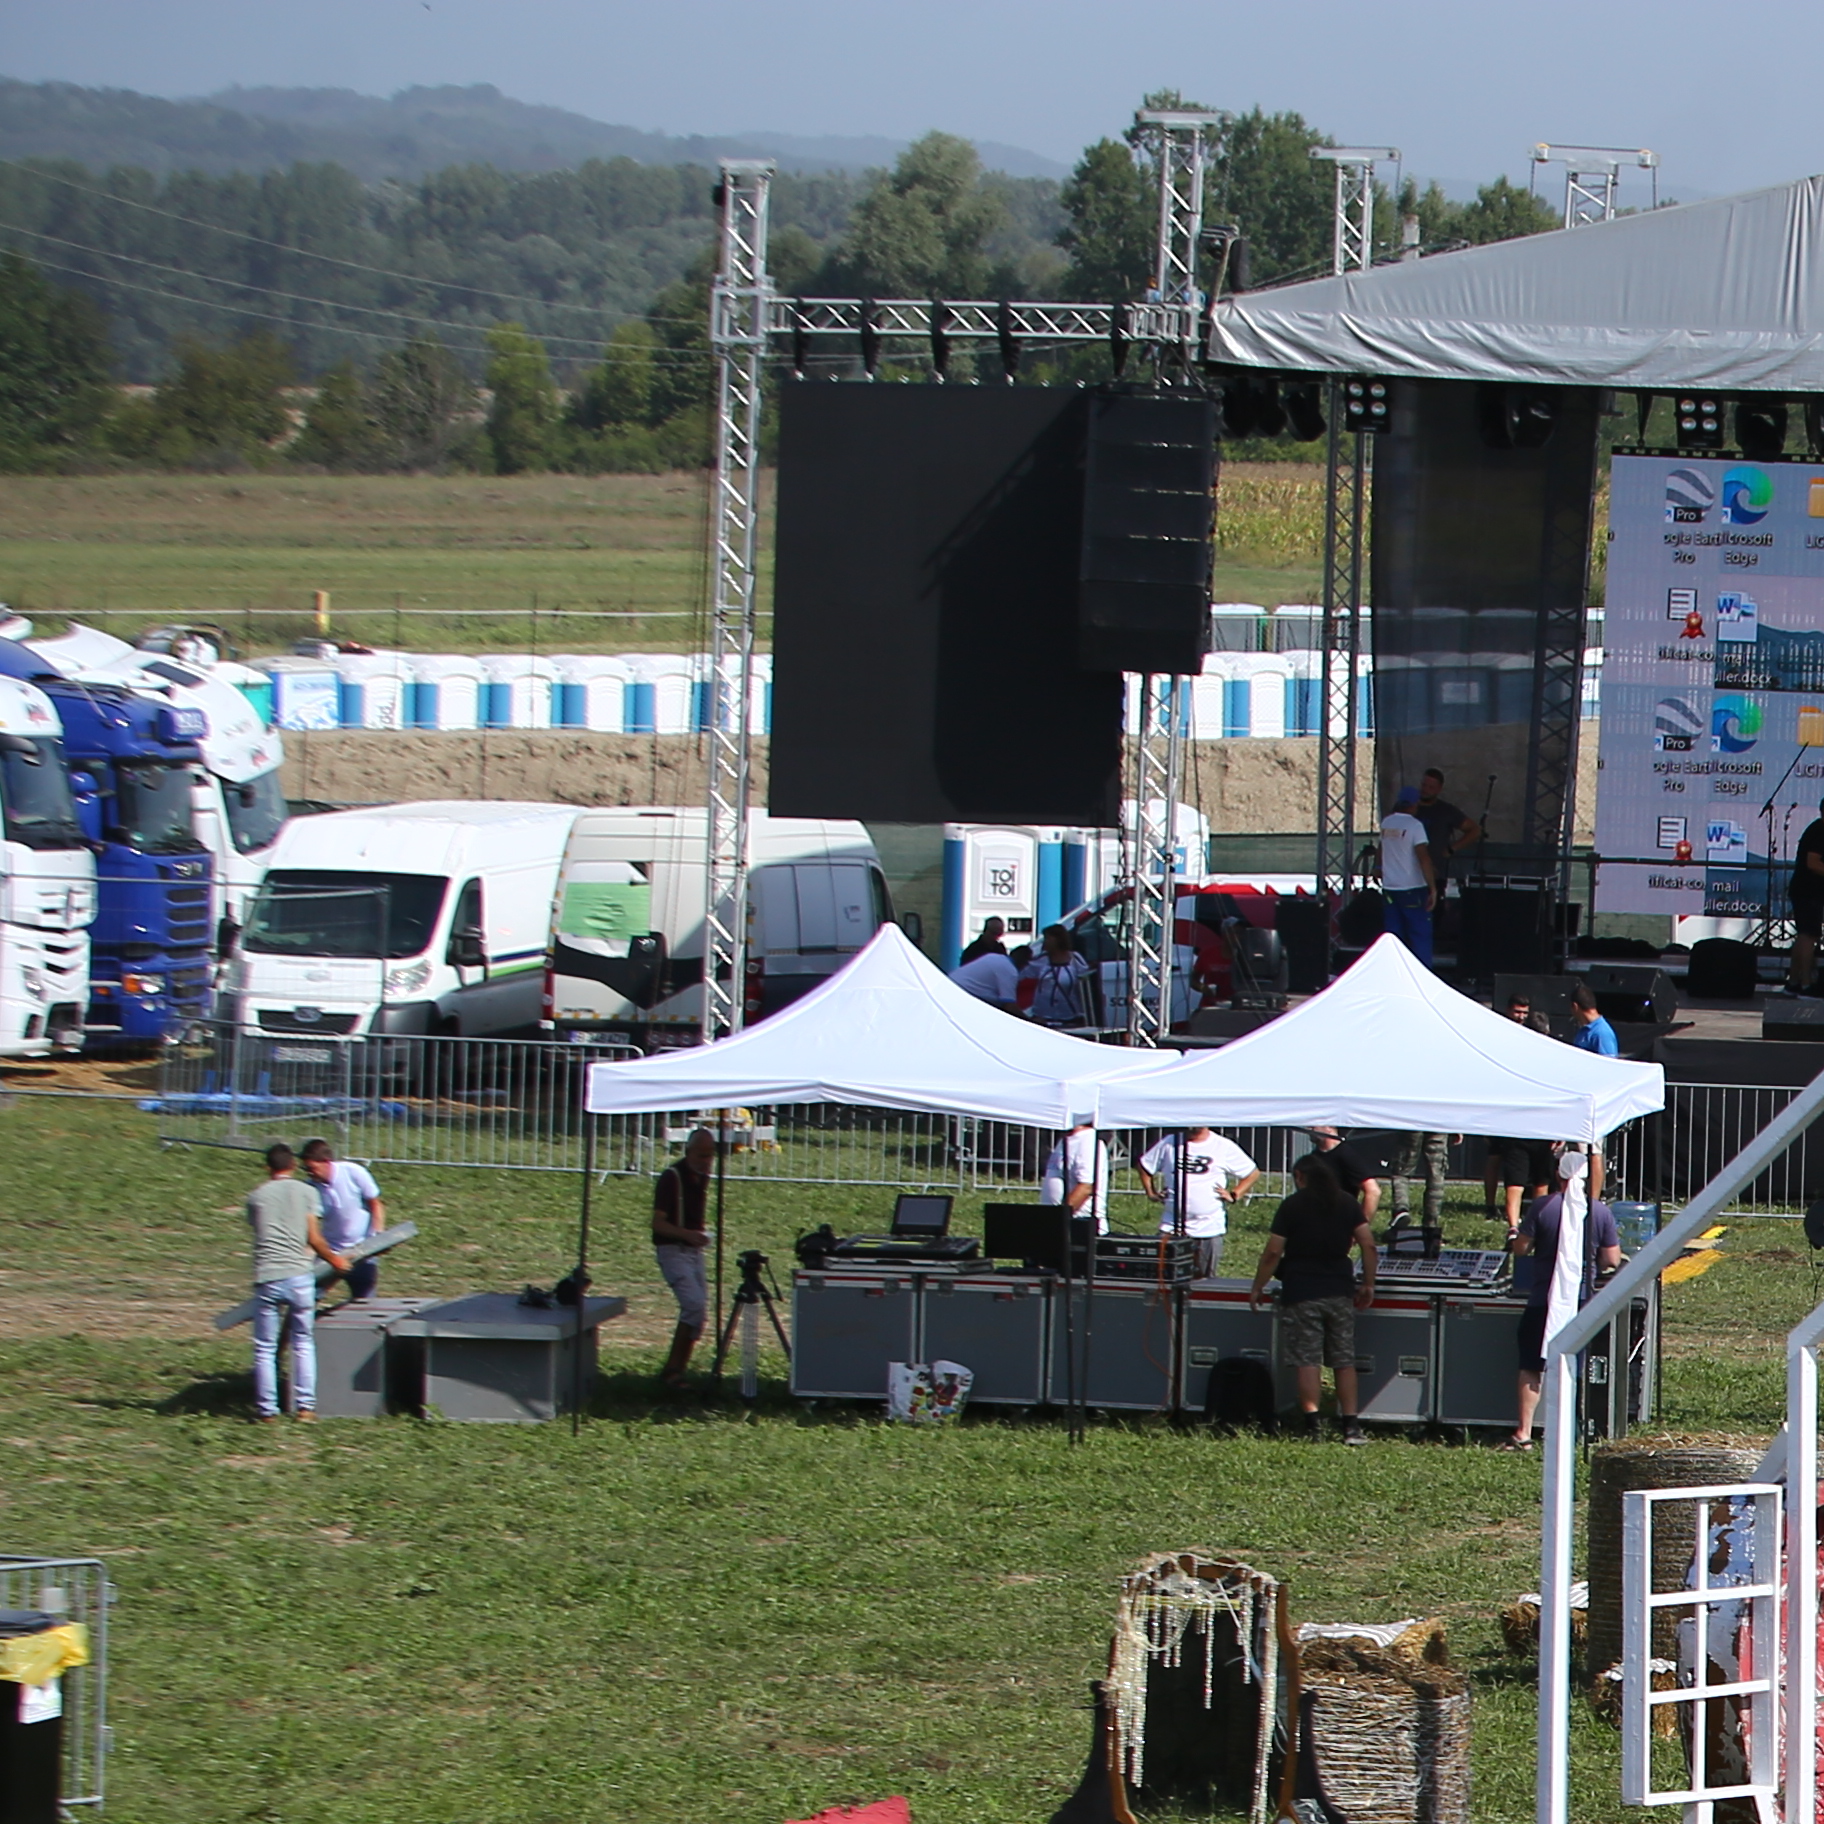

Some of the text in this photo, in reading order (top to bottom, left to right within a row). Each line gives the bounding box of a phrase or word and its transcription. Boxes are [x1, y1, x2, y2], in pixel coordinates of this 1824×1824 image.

[1676, 510, 1696, 521] Pro
[1674, 550, 1696, 564] Pro
[1724, 550, 1758, 568] Edge
[1666, 738, 1686, 750] Pro
[1663, 779, 1685, 793] Pro
[1714, 780, 1748, 797] Edge
[1712, 880, 1740, 893] mail
